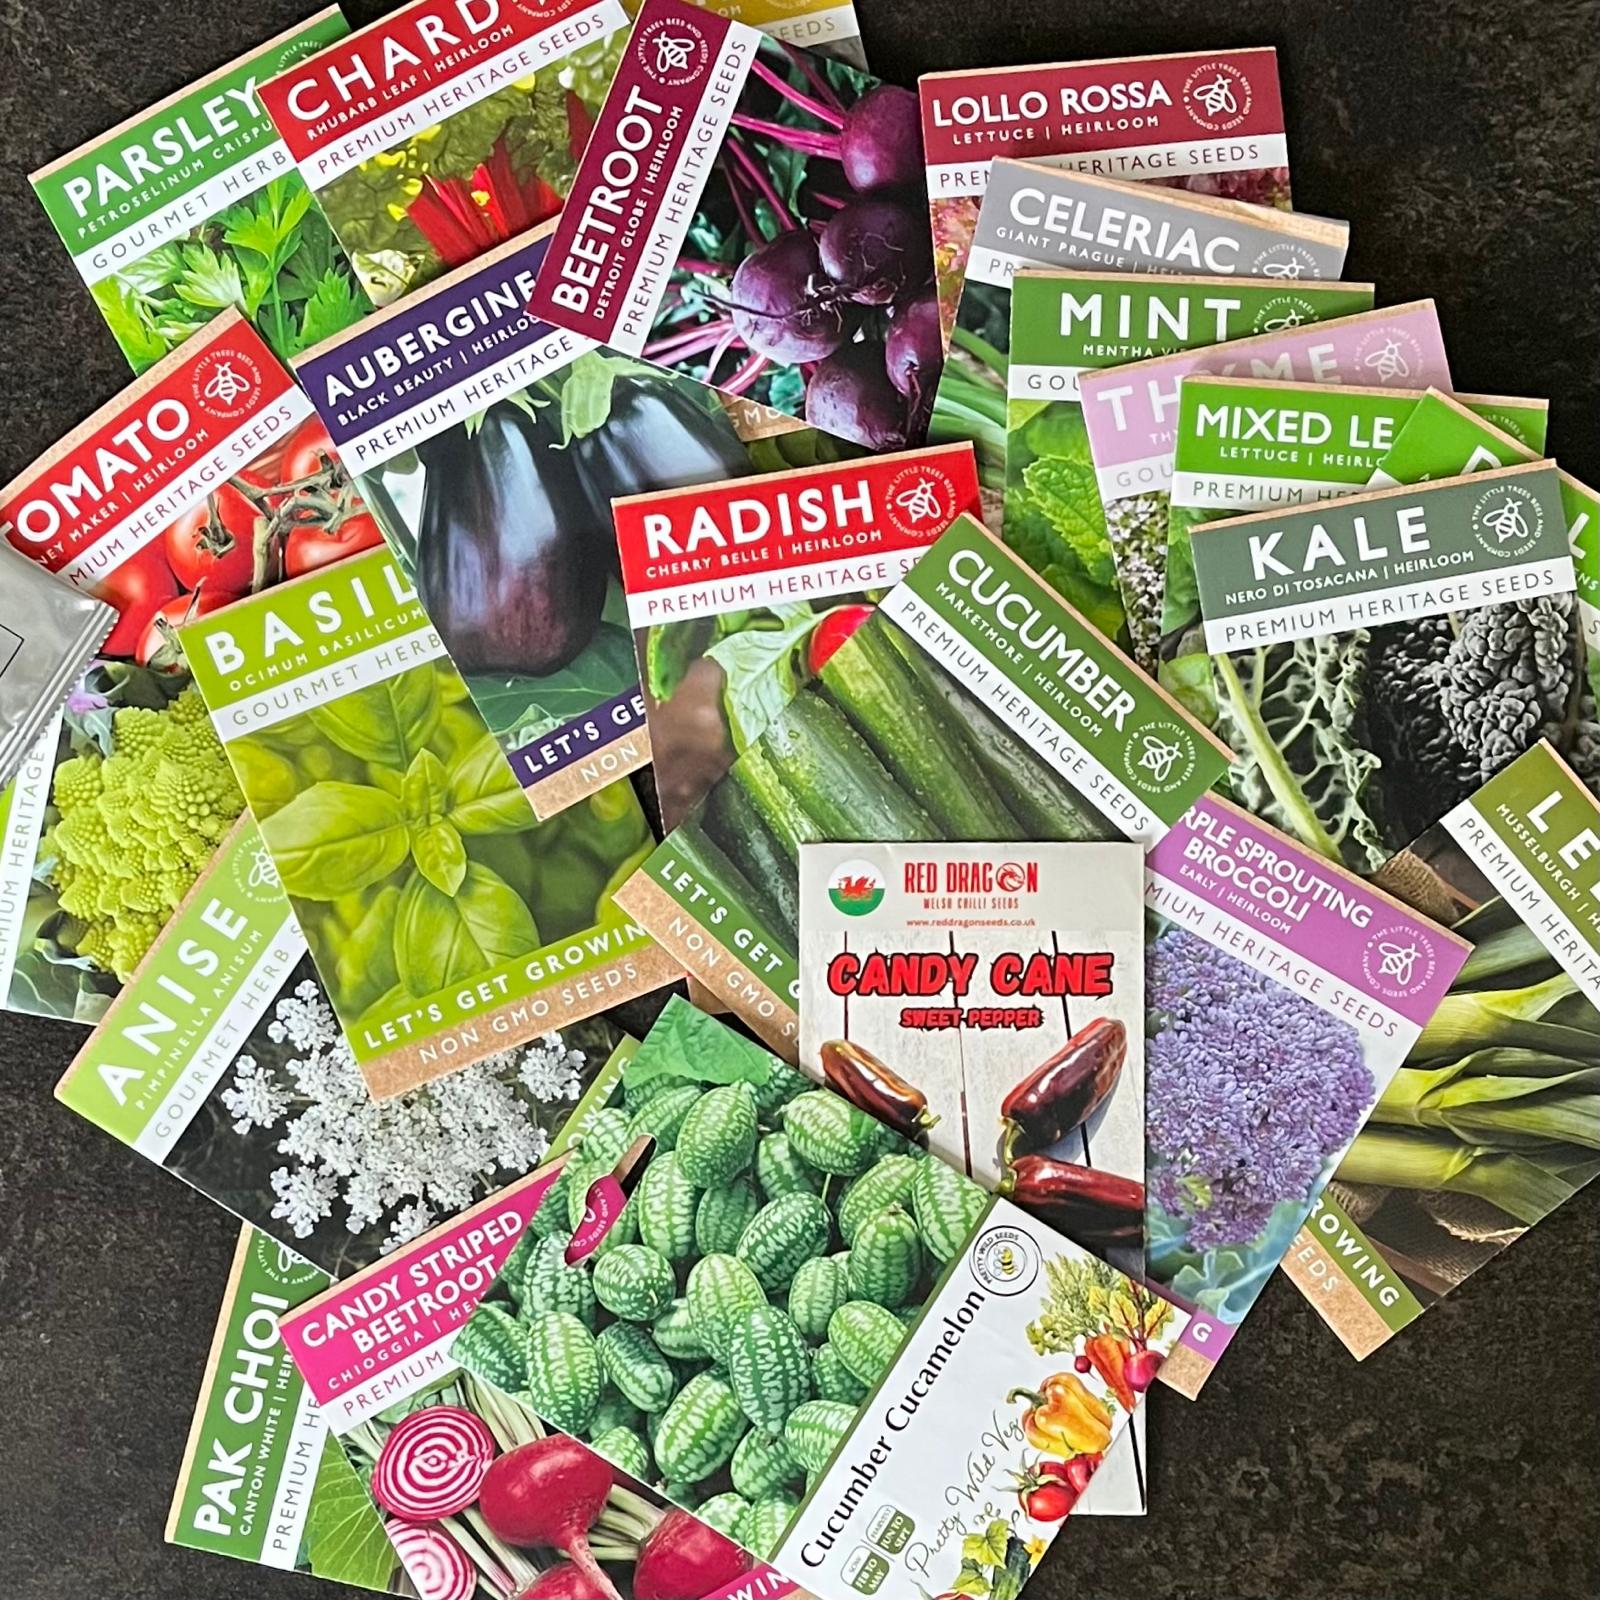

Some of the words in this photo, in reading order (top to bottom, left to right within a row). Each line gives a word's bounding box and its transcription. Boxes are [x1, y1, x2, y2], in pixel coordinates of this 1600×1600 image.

[287, 0, 500, 121] CHARD
[307, 97, 378, 140] RHUBARB
[383, 74, 418, 102] LEAF
[434, 24, 515, 72] HEIRLOOM
[318, 112, 415, 175] PREMIUM
[424, 51, 531, 117] HERITAGE
[538, 13, 604, 56] SEEDS
[932, 91, 1048, 128] LOLLO
[1061, 80, 1172, 115] ROSSA
[63, 76, 262, 218] PARSLEY
[78, 158, 205, 239] PETROSELINUM
[212, 121, 273, 159] CRISPU
[953, 127, 1035, 145] LETTUCE
[1061, 115, 1159, 136] HEIRLOOM
[1189, 144, 1259, 166] SEEDS
[93, 192, 209, 270] GOURMET
[224, 150, 287, 194] HERB
[551, 85, 663, 313] BEETROOT
[594, 253, 627, 320] DETROIT
[621, 200, 648, 249] GLOBE
[647, 106, 684, 184] HEIRLOOM
[623, 235, 673, 335] PREMIUM
[665, 114, 718, 223] HERITAGE
[711, 41, 747, 106] SEEDS
[1009, 187, 1240, 275] CELERIAC
[996, 227, 1050, 249] GIANT
[1058, 241, 1125, 267] PRAGUE
[326, 270, 537, 407] AUBERGINE
[1060, 292, 1241, 342] MINT
[1083, 344, 1152, 357] MENTHA
[337, 391, 389, 426] BLACK
[394, 357, 453, 397] BEAUTY
[472, 312, 537, 355] HEIRLO
[356, 400, 456, 460] PREMIUM
[463, 336, 574, 405] HERITAGE
[1097, 343, 1341, 431] THME
[1196, 404, 1332, 445] MIXED
[1350, 415, 1394, 449] LE
[1220, 446, 1299, 463] LETTUCE
[1323, 452, 1386, 468] HEIRLO
[69, 502, 119, 541] MAKER
[133, 429, 209, 493] HEIRLOOM
[69, 539, 125, 586] MIUM
[129, 456, 228, 539] HERITAGE
[231, 407, 292, 457] SEEDS
[644, 480, 874, 558] RADISH
[1193, 480, 1302, 502] PREMIUM
[646, 558, 712, 578] CHERRY
[720, 546, 769, 566] BELLE
[792, 530, 882, 555] HEIRLOOM
[648, 584, 755, 616] PREMIUM
[769, 563, 887, 596] HERITAGE
[1225, 586, 1266, 605] NERO
[1272, 582, 1290, 597] DI
[1296, 568, 1377, 592] TOSACANA
[1394, 550, 1474, 576] HEIRLOOM
[1249, 506, 1430, 581] KALE
[206, 564, 417, 676] BASIL
[229, 654, 309, 692] OCIMUM
[319, 609, 424, 657] BASILICUM
[948, 549, 1136, 732] CUCUMBER
[1225, 608, 1336, 643] PREMIUM
[1349, 584, 1469, 621] HERITAGE
[1482, 569, 1554, 597] SEEDS
[233, 665, 360, 726] GOURMET
[375, 633, 442, 670] HERB
[936, 582, 1023, 667] MARKETMORE
[1034, 673, 1103, 738] HEIRLOOM
[523, 722, 600, 773] LET'S
[612, 695, 647, 725] GE
[580, 745, 639, 783] NON
[901, 601, 989, 684] PREMIUM
[991, 683, 1087, 775] HERITAGE
[1090, 775, 1148, 831] SEEDS
[8, 751, 45, 867] HERITAGE
[1496, 803, 1581, 901] MUSSELBURGH
[660, 860, 728, 924] LET'S
[734, 929, 783, 973] GET
[905, 862, 937, 893] RED
[924, 898, 952, 909] WELSH
[992, 898, 1018, 909] SEEDS
[1179, 806, 1237, 849] RPLE
[1235, 837, 1374, 928] SPROUTING
[1179, 864, 1218, 891] EARLY
[1226, 891, 1292, 934] HEIRLOOM
[1183, 837, 1311, 922] BROCCOLI
[1459, 818, 1541, 910] PREMIUM
[1540, 913, 1600, 991] HERITA
[668, 917, 721, 968] NON
[726, 972, 774, 1017] GMO
[907, 918, 1036, 929] www.reddragonseeds.co.uk
[1146, 882, 1205, 925] MIUM
[1212, 922, 1324, 994] HERITAGE
[1331, 990, 1397, 1038] SEEDS
[97, 898, 248, 1106] ANISE
[136, 1006, 213, 1110] PIMPINELLA
[214, 930, 263, 999] ANISUM
[364, 1005, 442, 1049] LET'S
[456, 975, 509, 1010] GET
[525, 922, 647, 982] GROWIN
[418, 1028, 480, 1065] NON
[492, 1000, 549, 1033] GMO
[562, 963, 638, 1006] SEEDS
[827, 952, 978, 997] CANDY
[990, 952, 1114, 997] CANE
[900, 1007, 962, 1030] SWEET
[967, 1007, 1043, 1030] PEPPER
[155, 1019, 241, 1138] GOURMET
[241, 950, 289, 1010] HERB
[301, 1275, 402, 1348] CANDY
[408, 1210, 523, 1287] STRIPED
[1290, 1234, 1338, 1292] EEDS
[1310, 1198, 1400, 1308] ROWING
[351, 1254, 499, 1354] BEETROOT
[327, 1330, 425, 1390] CHIOGGIA
[343, 1352, 445, 1416] PREMIUM
[194, 1438, 253, 1536] PAK
[224, 1292, 289, 1424] CHOI
[800, 1436, 892, 1567] Cucumber
[885, 1291, 985, 1432] Cucamelon
[240, 1462, 266, 1536] CANTON
[258, 1408, 280, 1459] WHITE
[273, 1440, 312, 1550] PREMIUM
[891, 1515, 904, 1530] TO
[905, 1512, 967, 1578] Pretty
[945, 1452, 995, 1507] Wild
[981, 1409, 1025, 1452] Veg
